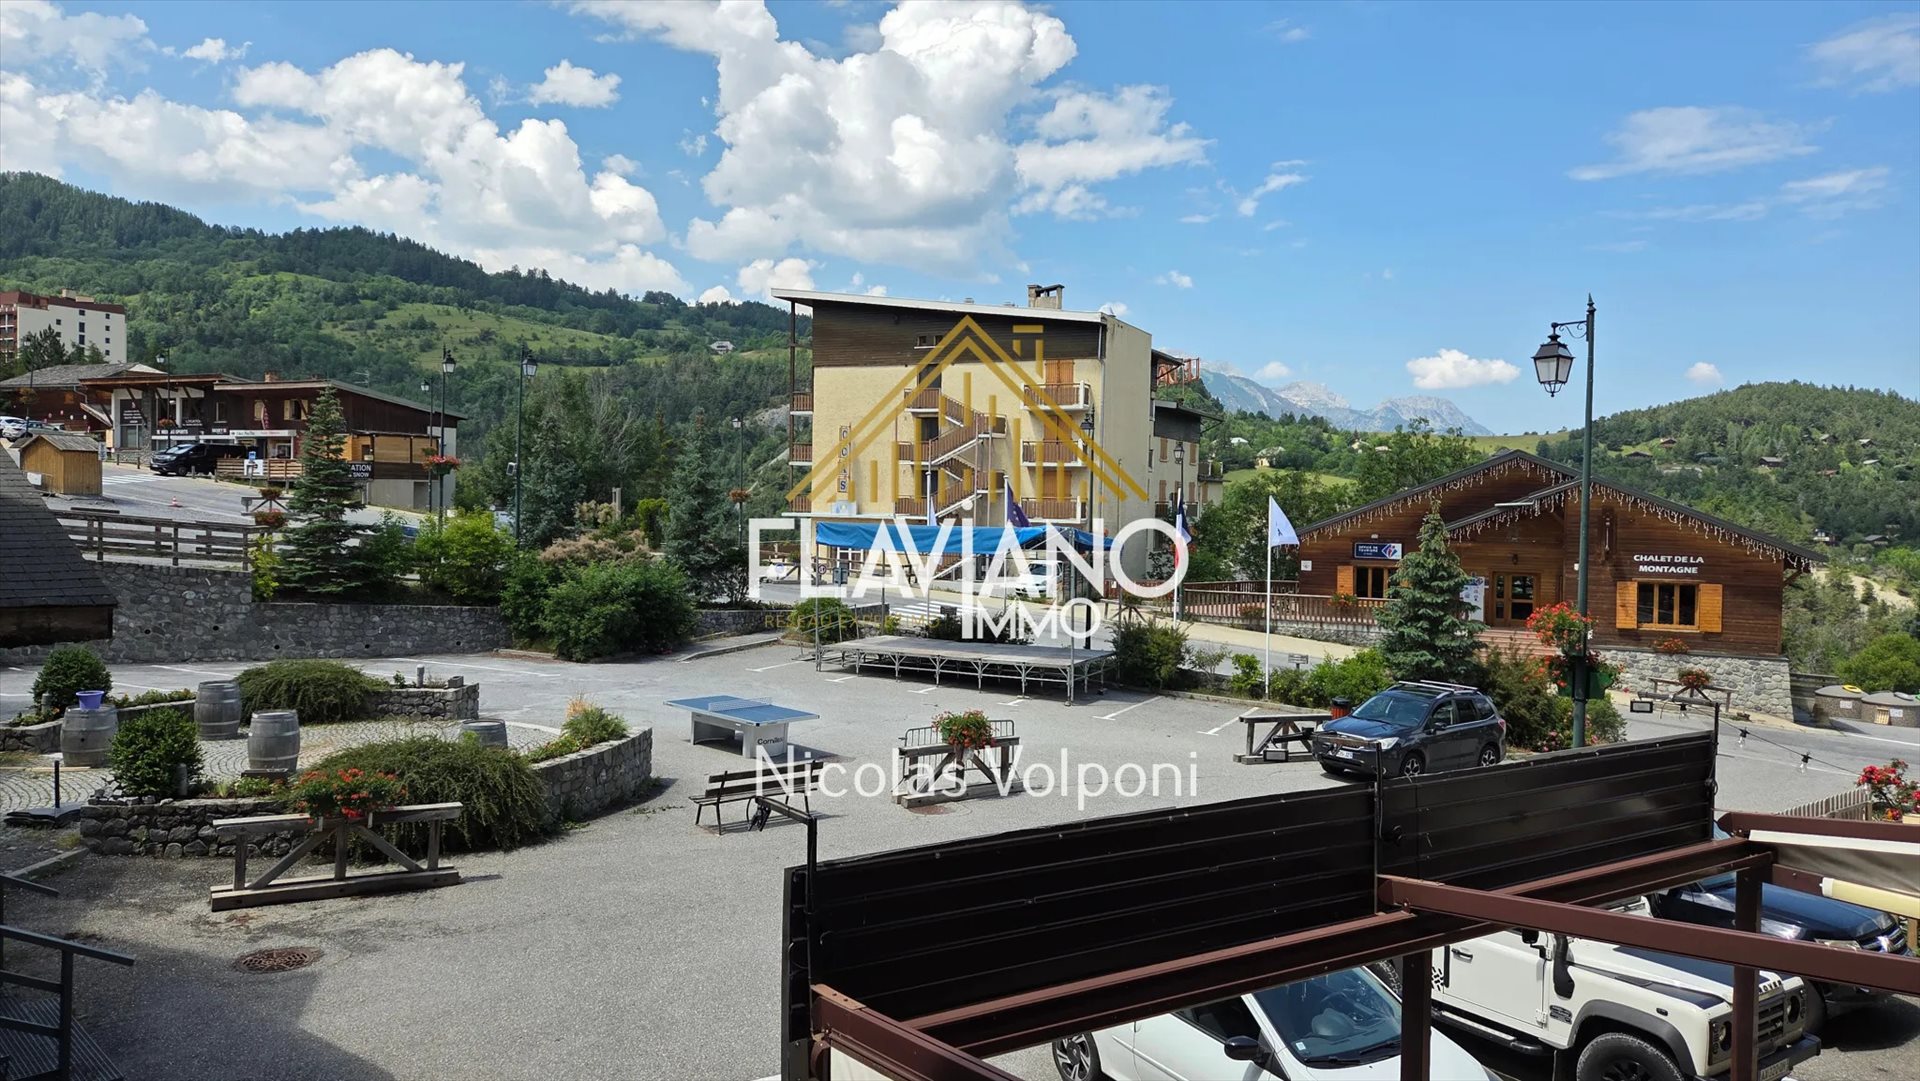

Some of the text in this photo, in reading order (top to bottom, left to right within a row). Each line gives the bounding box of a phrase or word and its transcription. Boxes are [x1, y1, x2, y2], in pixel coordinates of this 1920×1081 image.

[350, 464, 372, 472] ATION
[1633, 554, 1673, 562] CHALET
[1674, 555, 1688, 563] DE
[1639, 565, 1698, 574] MONTAGNE
